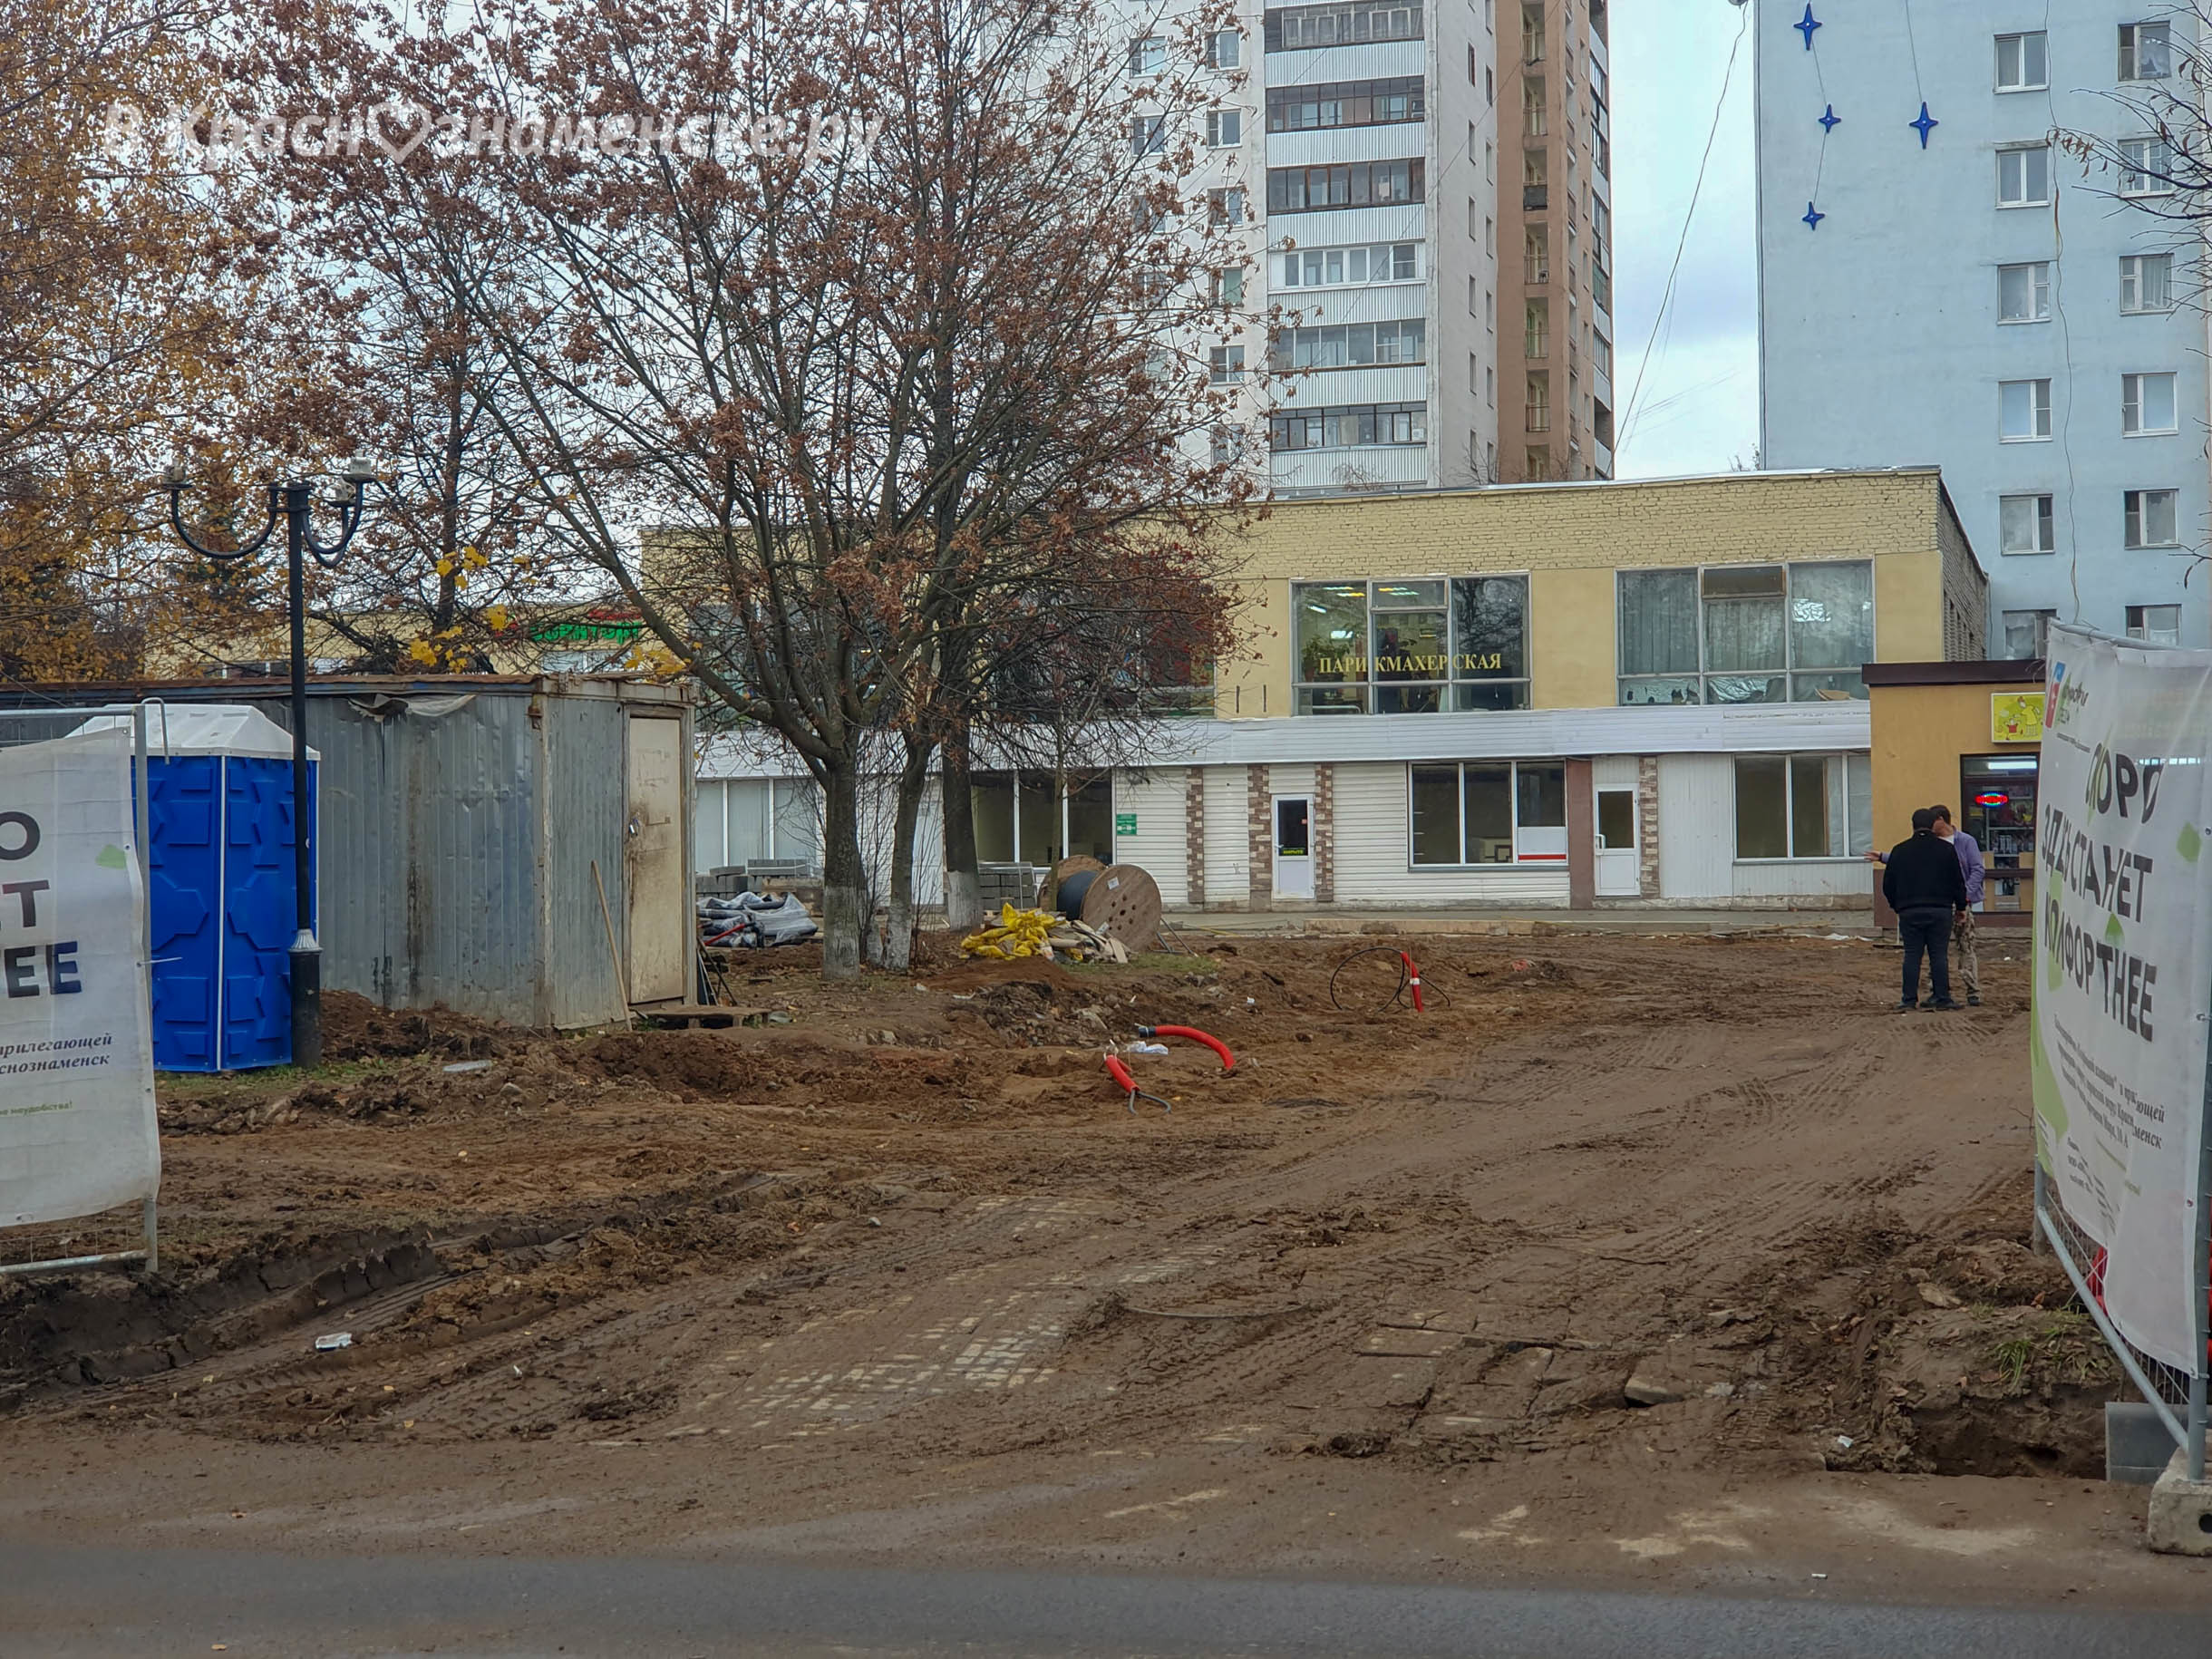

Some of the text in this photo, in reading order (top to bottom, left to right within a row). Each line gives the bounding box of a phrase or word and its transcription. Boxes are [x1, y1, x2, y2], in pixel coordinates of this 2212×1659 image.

[1319, 652, 1502, 674] ПАРИКМАХЕРСКАЯ
[4, 941, 82, 998] ЕЕ
[0, 1054, 111, 1075] снознаменск
